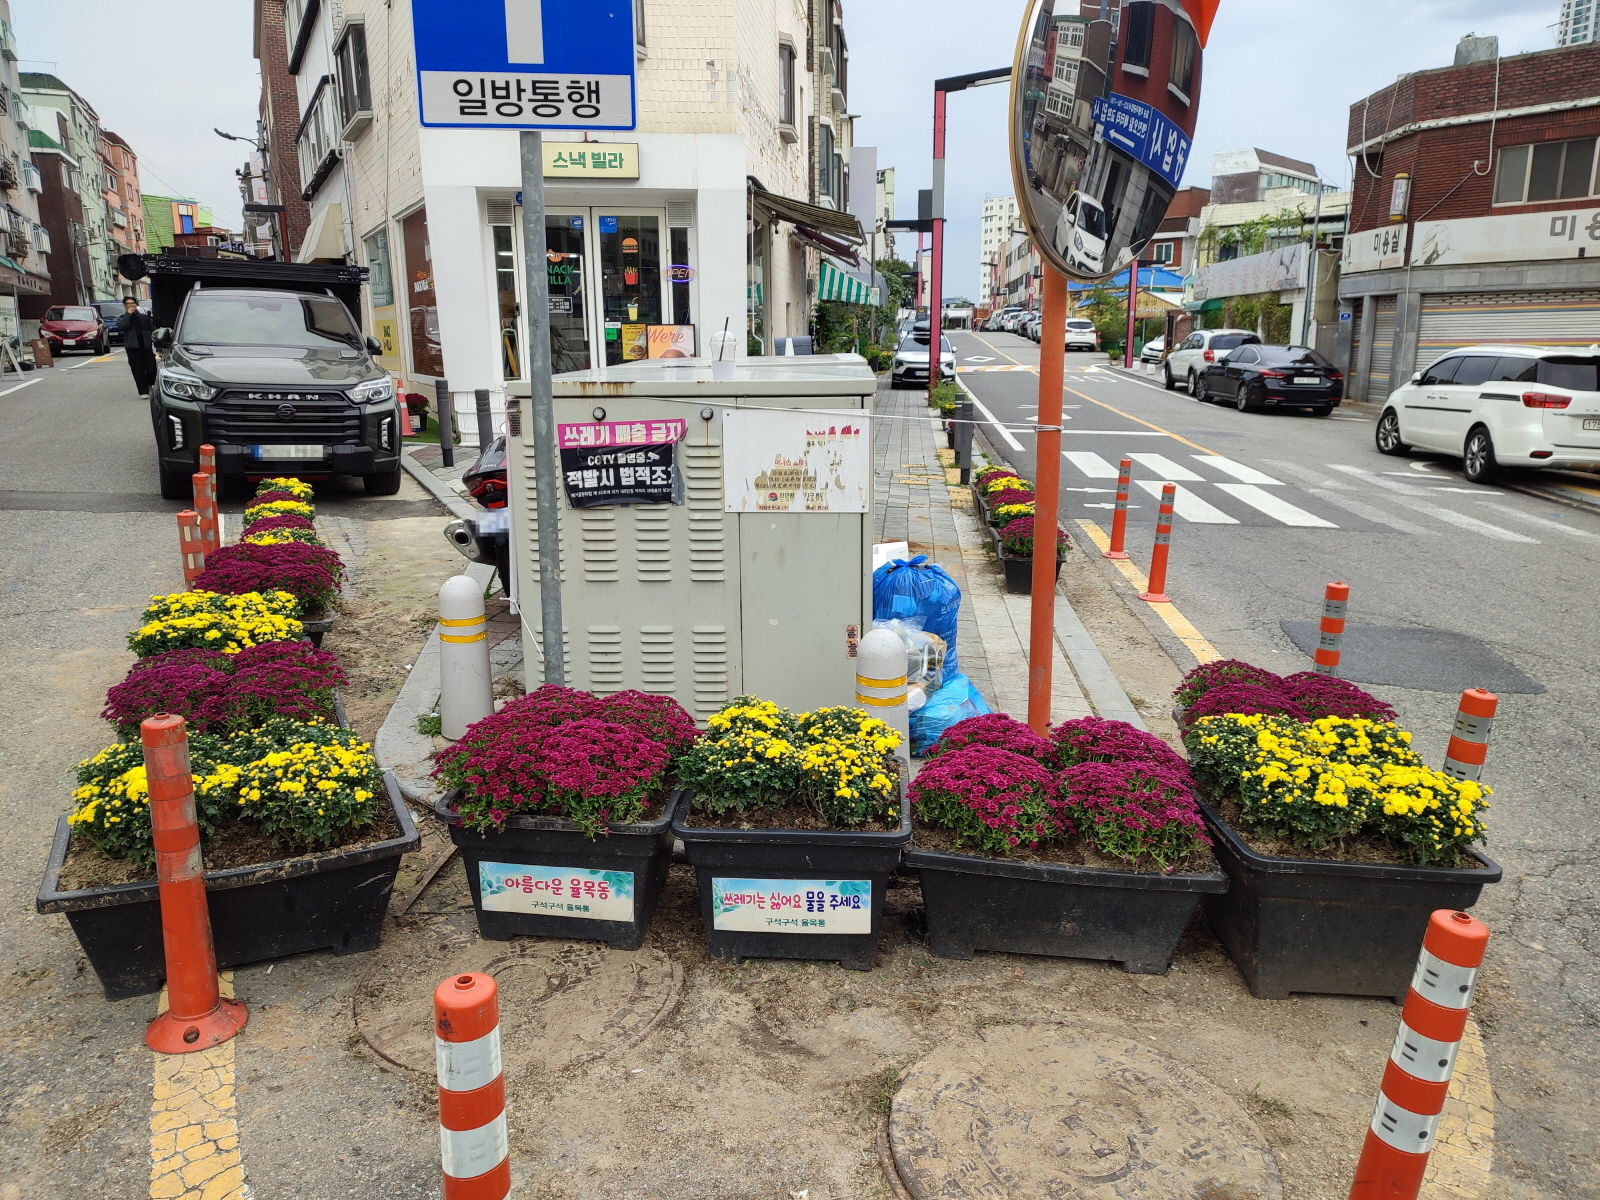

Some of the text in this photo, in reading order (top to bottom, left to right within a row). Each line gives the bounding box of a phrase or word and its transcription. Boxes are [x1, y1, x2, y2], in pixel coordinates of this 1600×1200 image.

[452, 78, 602, 119] 일방통행
[552, 151, 624, 169] 스낵 빌라
[1373, 229, 1401, 256] 미용실
[547, 265, 574, 274] NACK
[663, 268, 695, 279] OPEN
[547, 276, 572, 284] ILLA
[648, 327, 686, 344] Were
[564, 421, 683, 447] 쓰레기 배출 금지
[587, 451, 646, 466] CCTV 촬영중
[567, 466, 673, 489] 적발시 법적조
[504, 875, 611, 900] 아름다운 율목동
[531, 900, 564, 910] 구석구석
[723, 891, 862, 913] 쓰레기는 싫어요 물을 주세요
[765, 917, 799, 926] 구석구석
